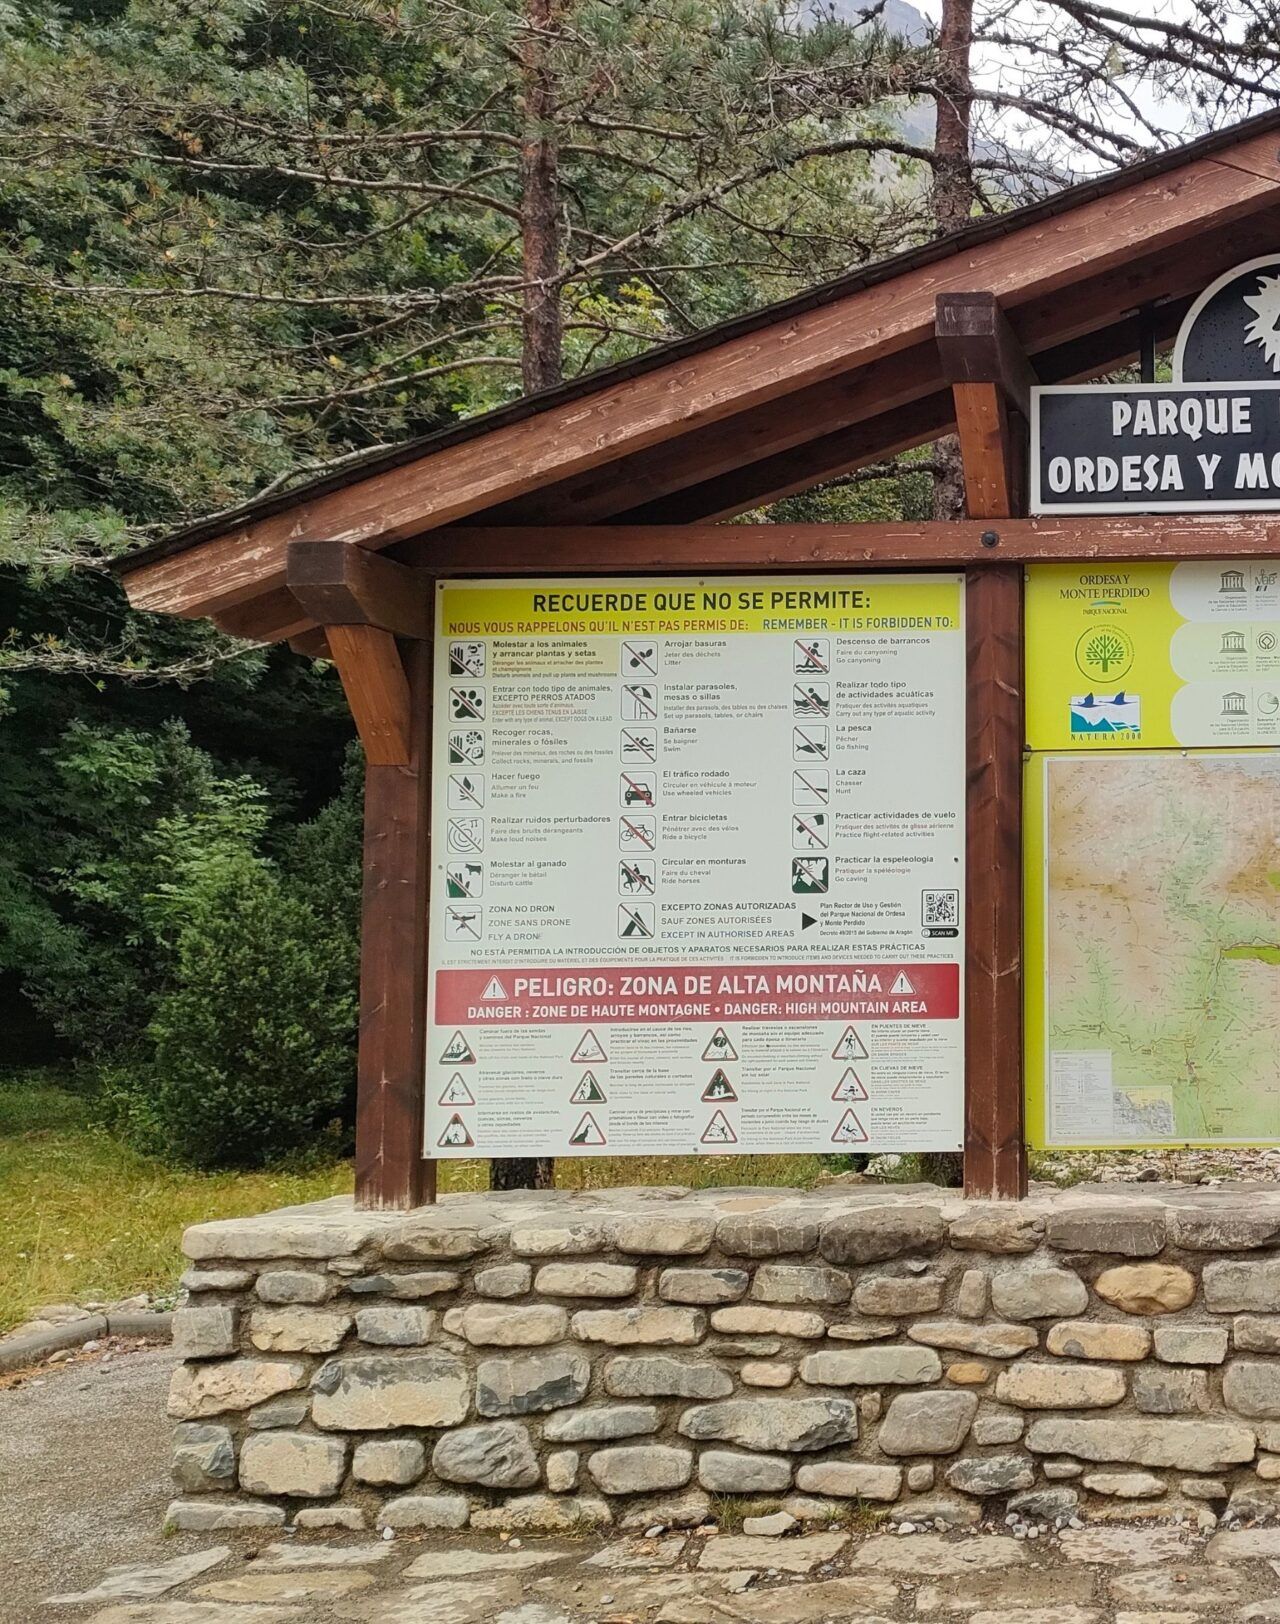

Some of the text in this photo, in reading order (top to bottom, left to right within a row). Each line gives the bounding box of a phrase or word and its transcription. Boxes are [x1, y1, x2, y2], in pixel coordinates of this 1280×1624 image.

[1112, 398, 1251, 441] PARQUE
[1048, 454, 1184, 493] ORDESA
[1080, 575, 1121, 585] ORDESA
[1060, 588, 1150, 599] MONTE PERDIDO
[534, 591, 870, 612] RECUERDE QUE NO SE PERMITE:
[450, 620, 748, 633] NOUS VOUS RAPPELONS QU'IL N'EST PAS PERMIS DE:
[764, 619, 827, 629] REMEMBER
[840, 618, 849, 628] IT
[853, 618, 862, 628] IS
[867, 617, 932, 628] FORBIDDEN
[936, 617, 952, 627] TO:
[493, 693, 528, 701] EXCEPTO
[531, 693, 562, 701] PERROS
[515, 970, 882, 996] PELIGRO: ZONA DE ALTA MONTAÑA
[468, 1006, 521, 1018] DANGER
[533, 1006, 567, 1017] ZONE
[571, 1006, 588, 1017] DE
[592, 1005, 635, 1016] HAUTE
[639, 1004, 711, 1016] MONTAGNE
[725, 1002, 927, 1015] DANGER: HIGH MOUNTAIN AREA
